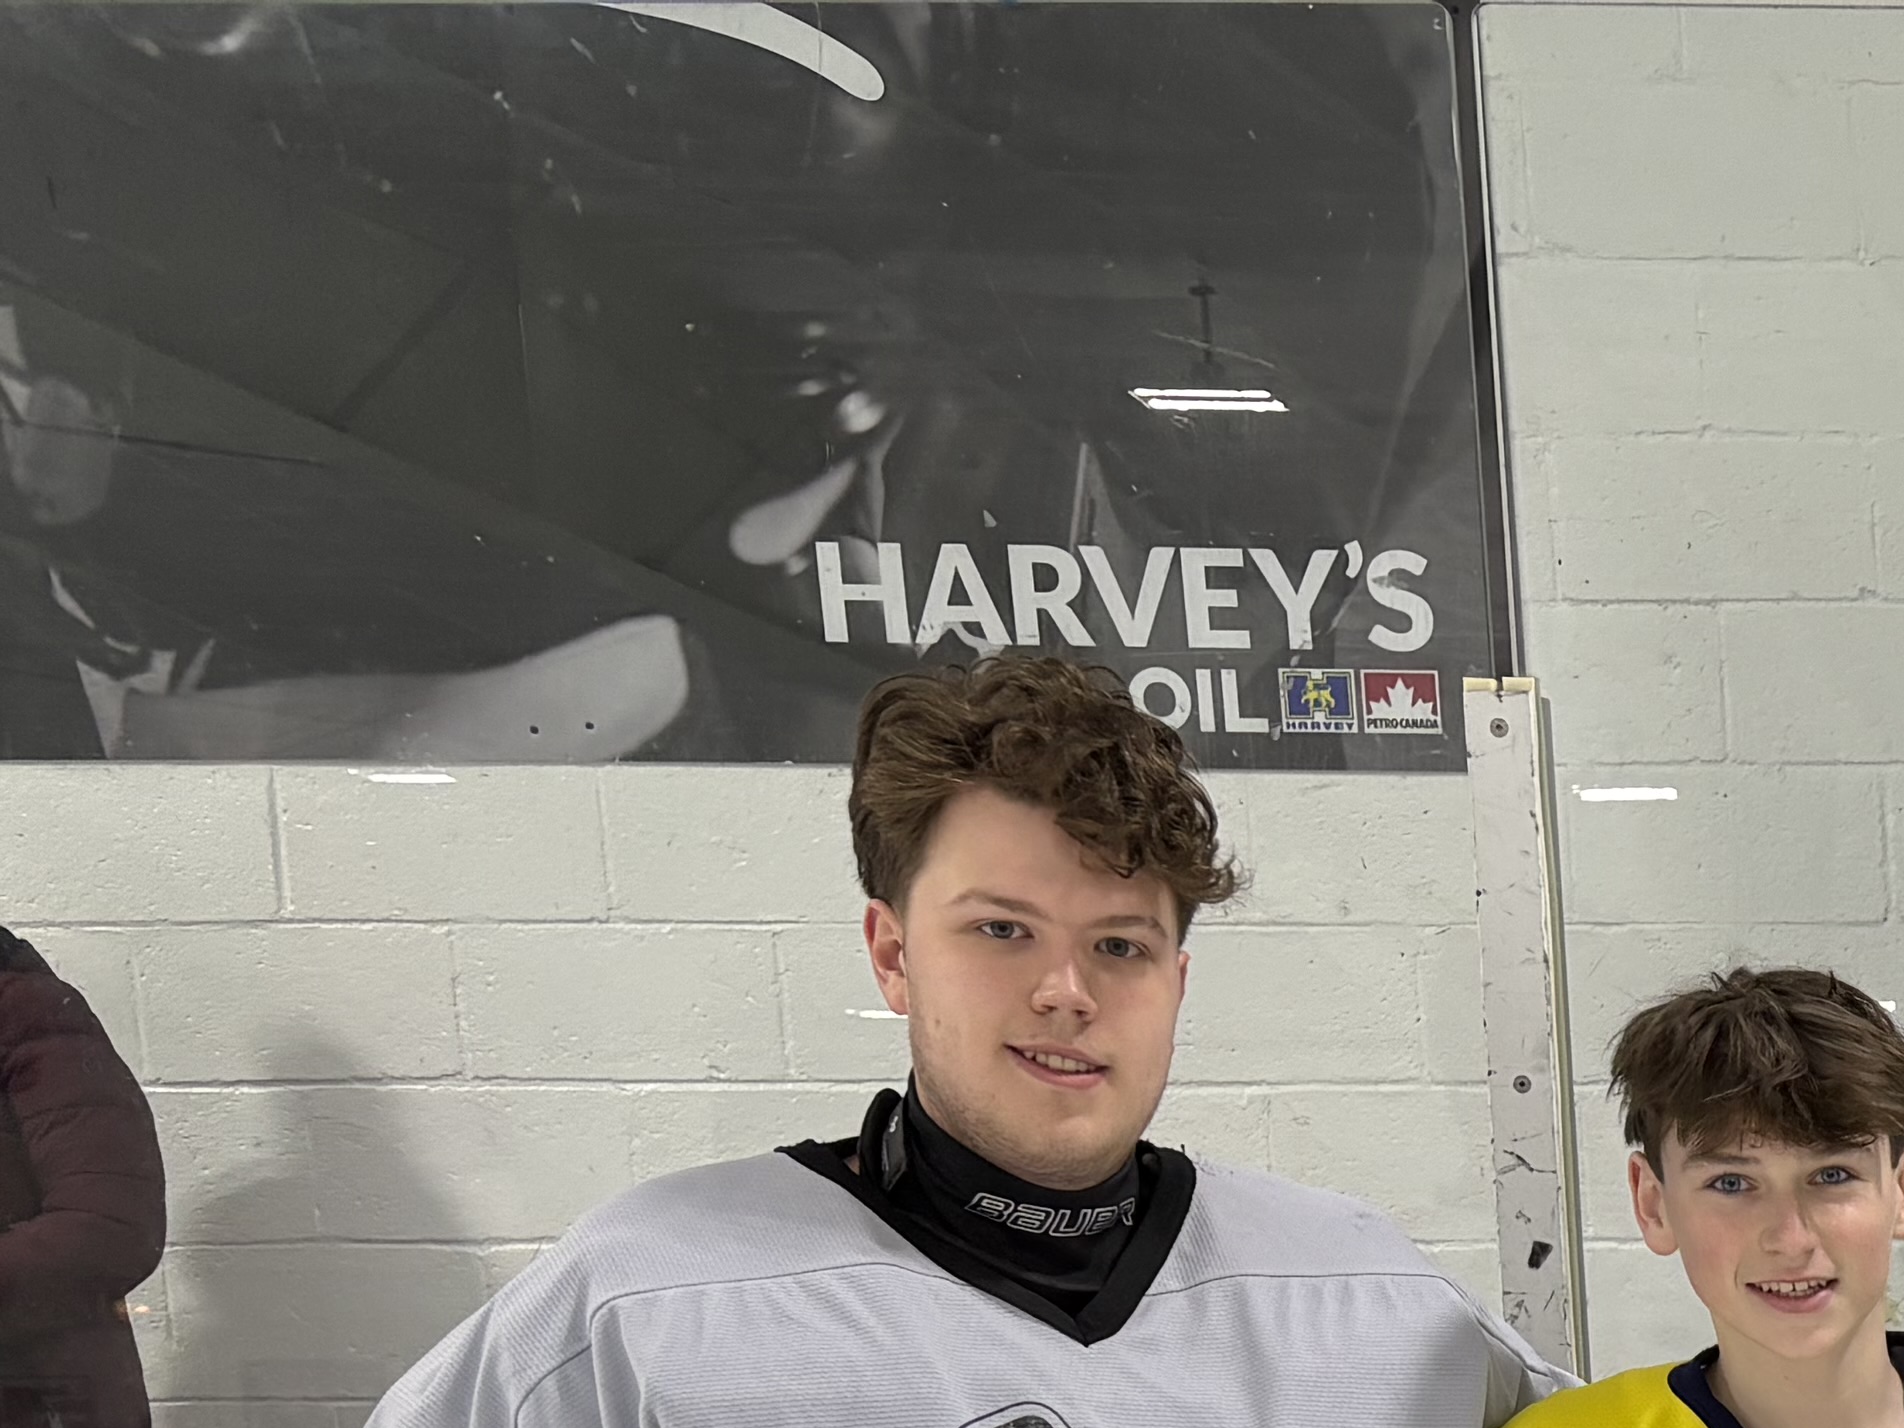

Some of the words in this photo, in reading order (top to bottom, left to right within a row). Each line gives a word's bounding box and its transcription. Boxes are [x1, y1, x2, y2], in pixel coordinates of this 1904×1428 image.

[814, 540, 1435, 653] HARVEY'S
[1129, 666, 1269, 733] OIL
[1286, 721, 1355, 731] HARVEY
[964, 1192, 1135, 1237] BAUER
